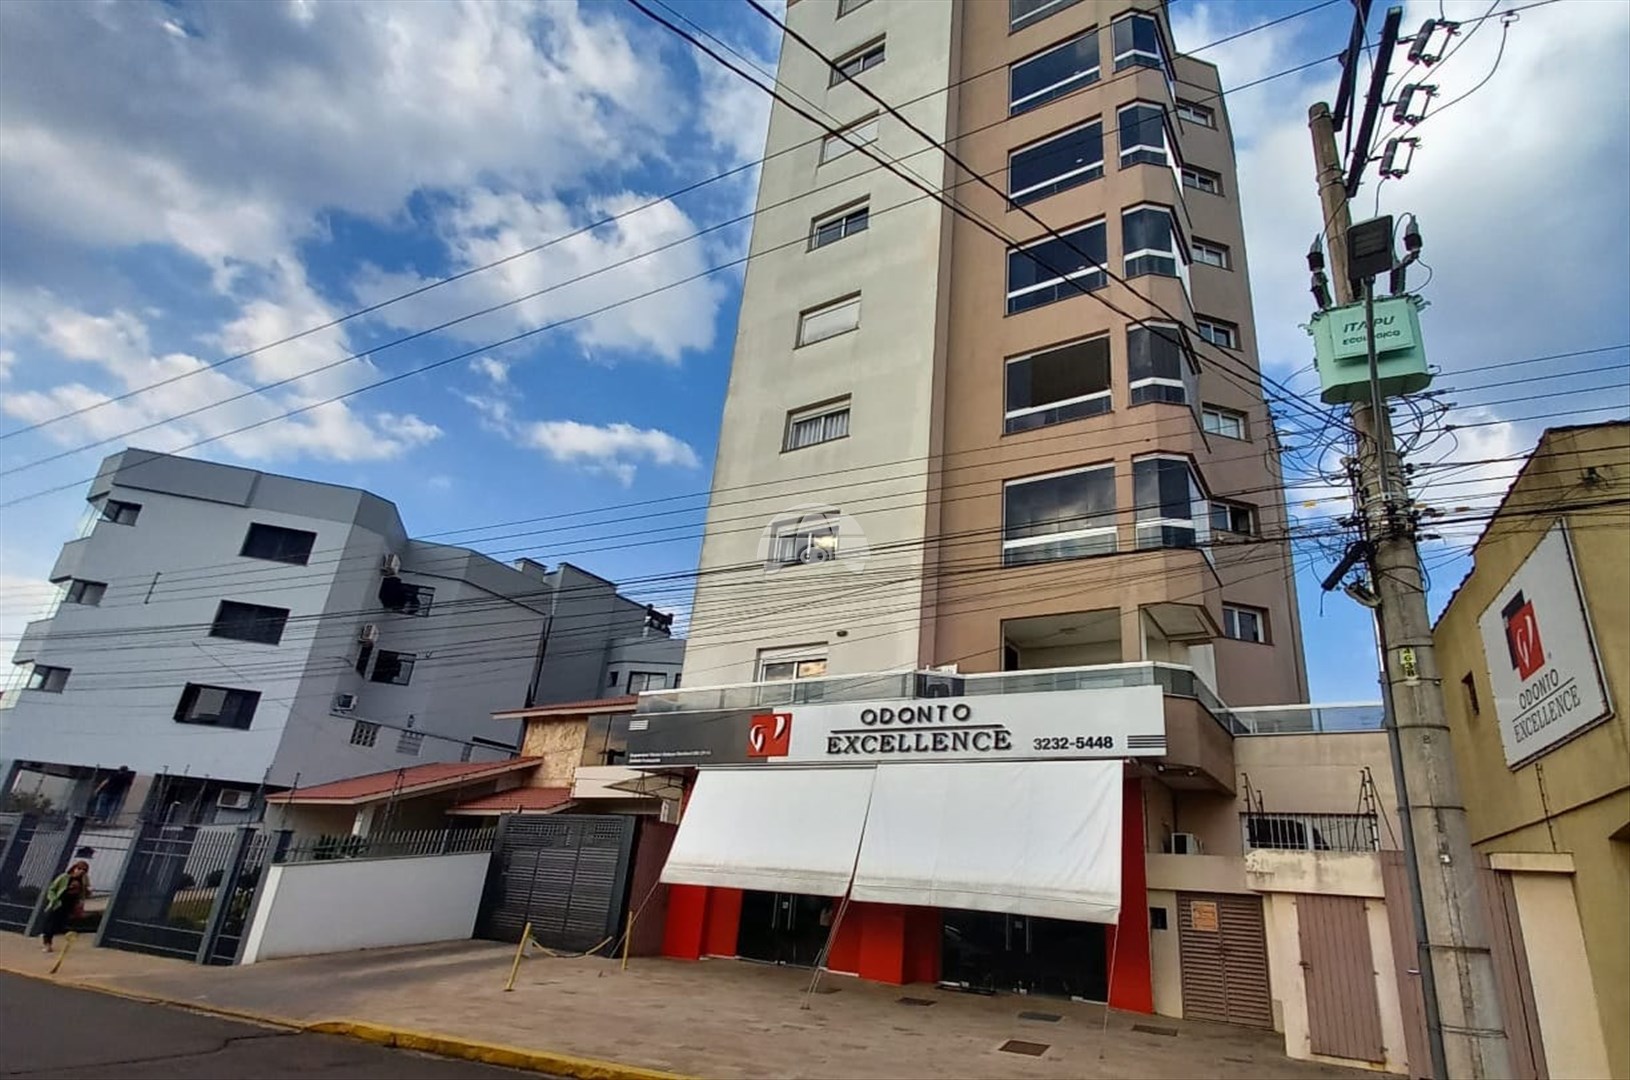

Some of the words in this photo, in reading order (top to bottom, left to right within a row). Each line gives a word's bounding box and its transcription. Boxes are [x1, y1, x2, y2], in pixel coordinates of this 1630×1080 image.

[1344, 316, 1395, 333] ITAPU
[1518, 668, 1559, 710] ODONTO
[860, 704, 971, 726] ODONTO
[1513, 685, 1581, 743] EXCELLENCE
[827, 730, 1012, 754] EXCELLENCE
[1033, 736, 1114, 751] 3232-5448
